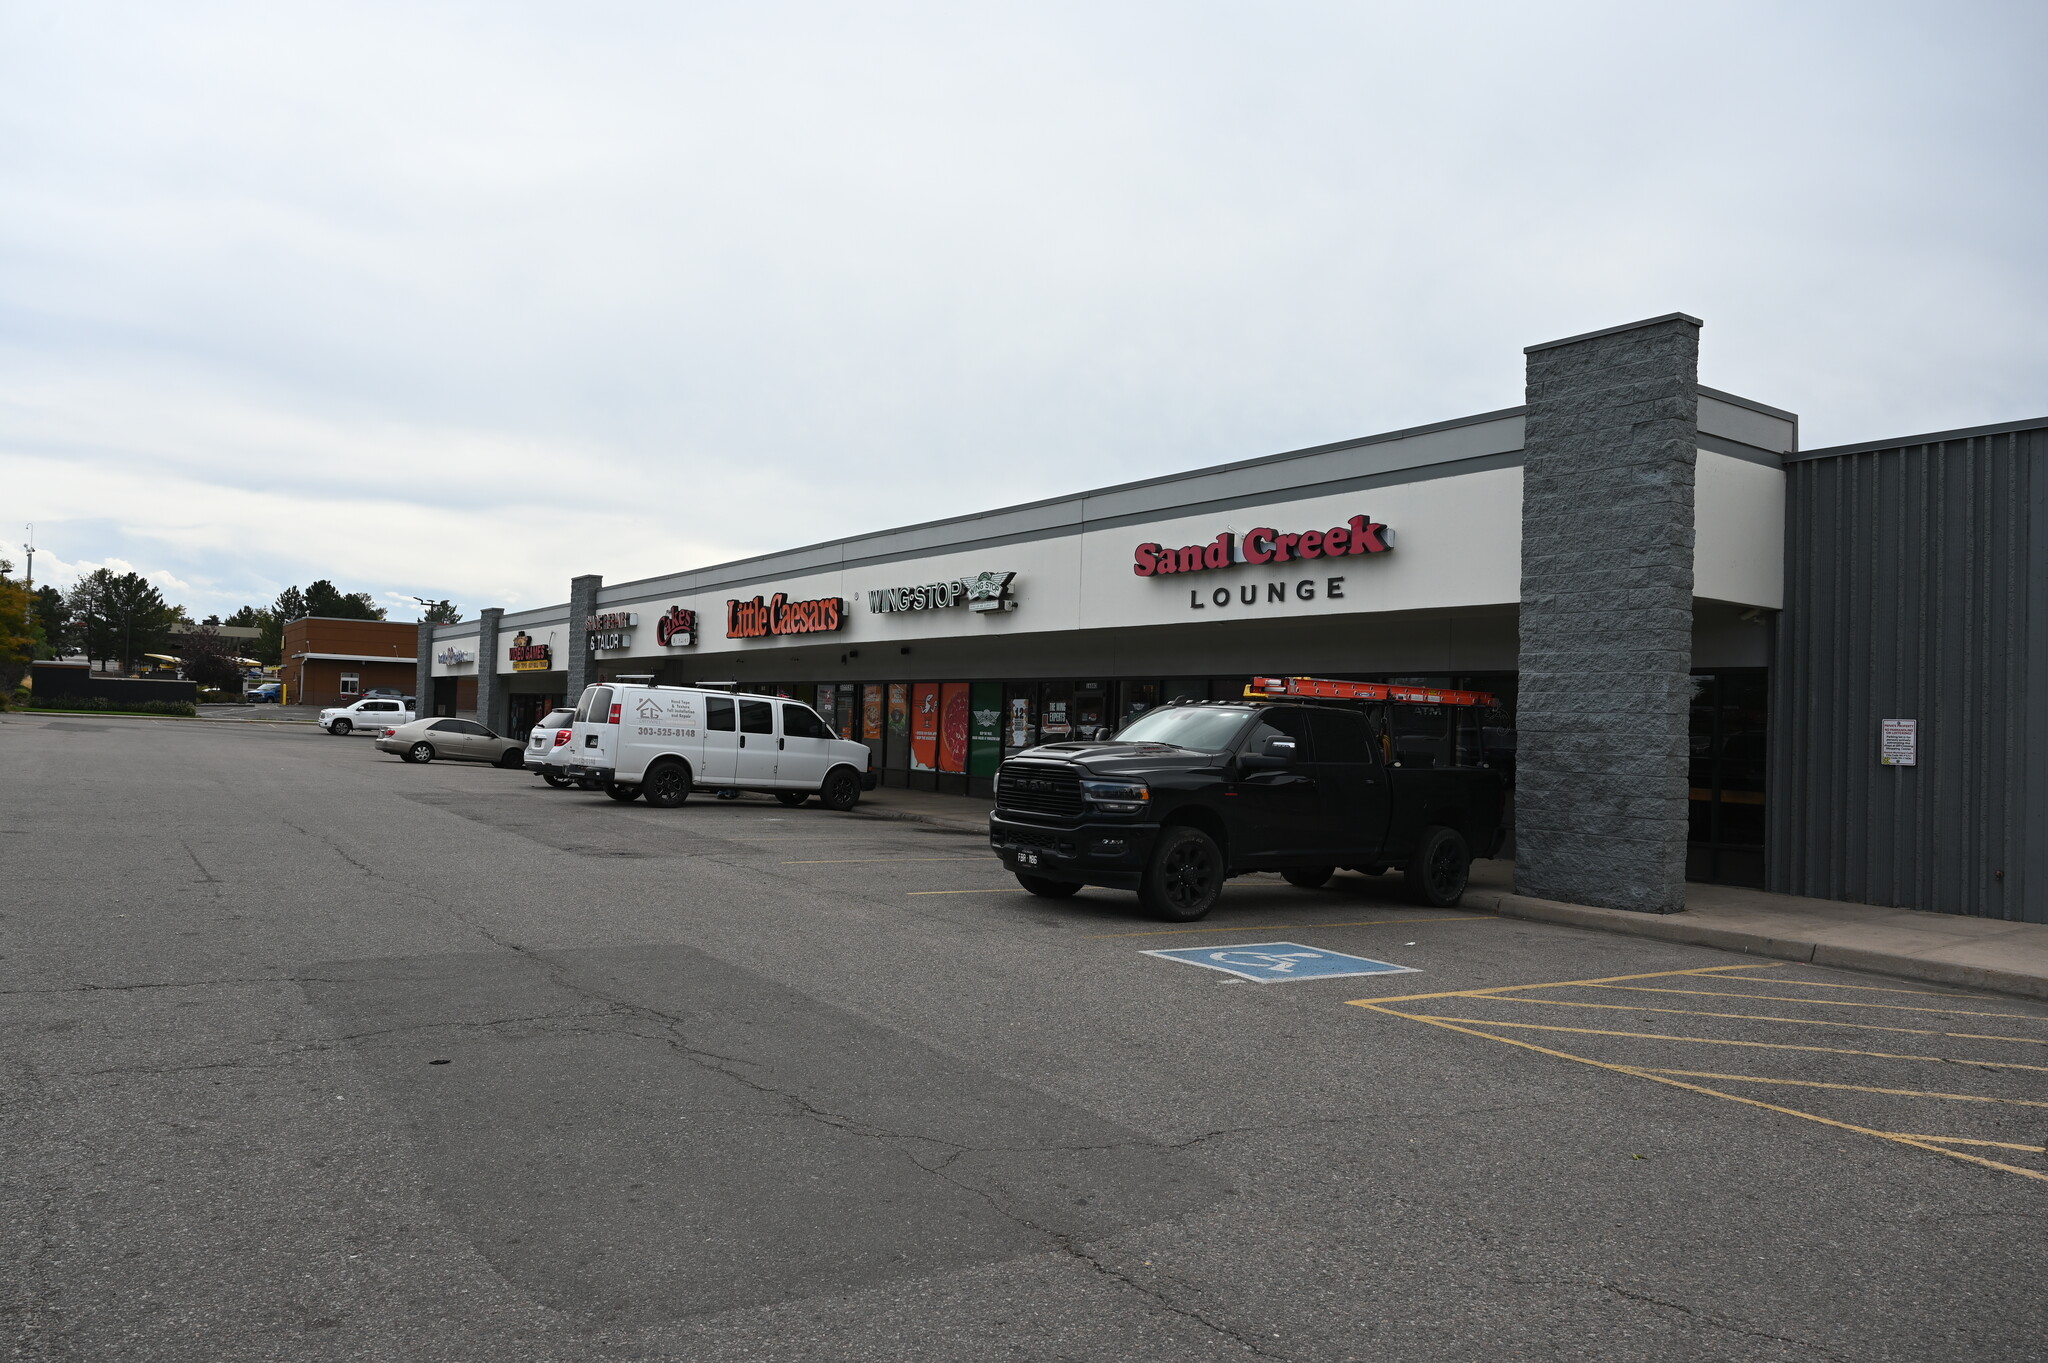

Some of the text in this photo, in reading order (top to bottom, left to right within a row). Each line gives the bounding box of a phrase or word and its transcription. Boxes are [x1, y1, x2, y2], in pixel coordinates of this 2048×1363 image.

[1134, 514, 1388, 577] Sand Creek
[1190, 577, 1344, 609] LOUNGE
[585, 612, 628, 631] SHOE REPAIR
[727, 593, 841, 638] Little Caesars
[657, 605, 692, 647] Cakes
[597, 634, 619, 650] TAILOR
[509, 645, 545, 660] VIDEO GAMES
[640, 707, 660, 719] EG
[1015, 708, 1024, 719] 12
[1049, 712, 1067, 722] EXPERTS
